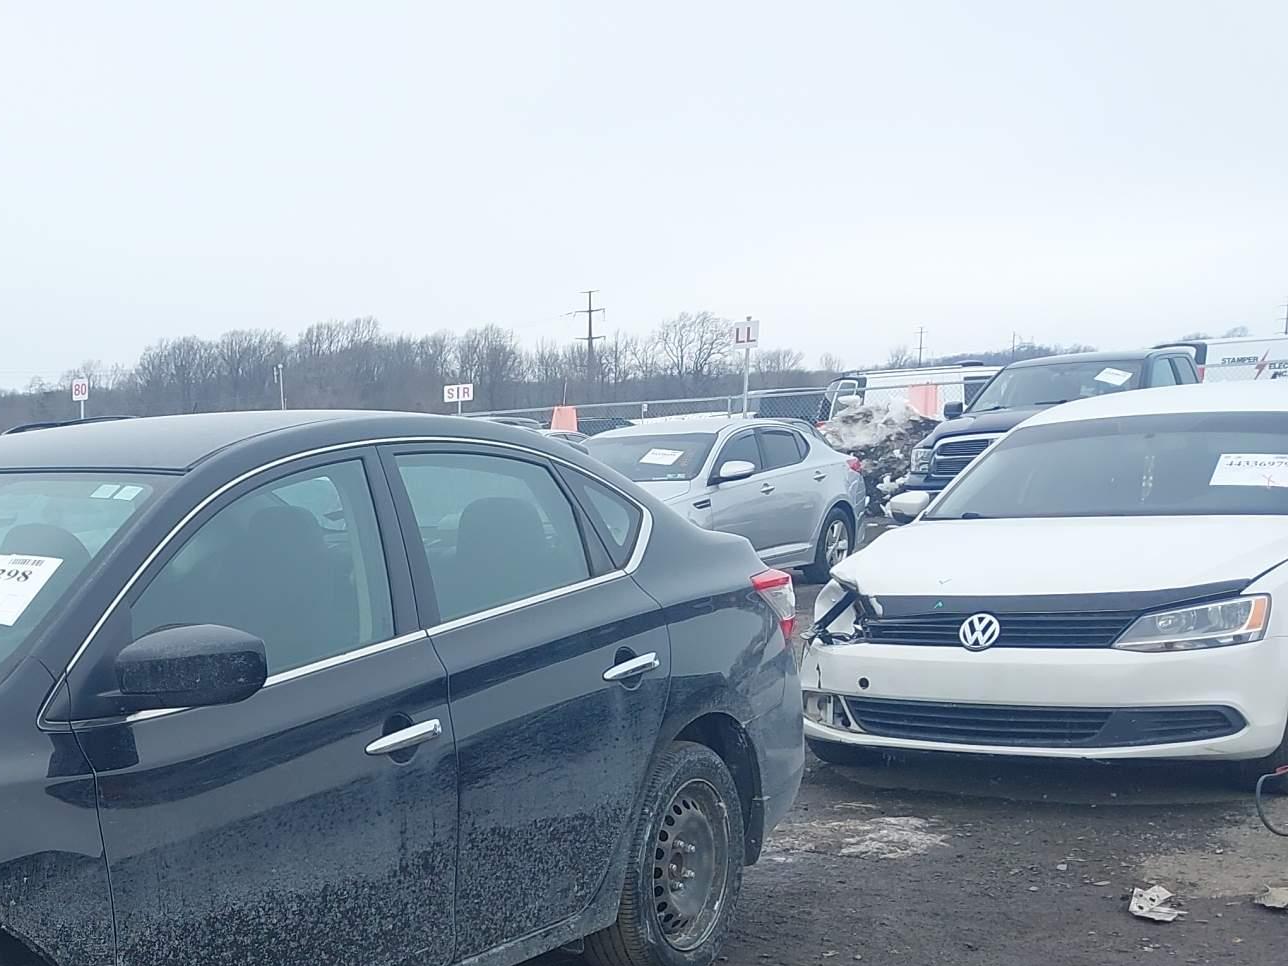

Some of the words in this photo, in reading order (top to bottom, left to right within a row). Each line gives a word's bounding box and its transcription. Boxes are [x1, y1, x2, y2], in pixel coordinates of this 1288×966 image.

[735, 326, 756, 344] LL
[1221, 356, 1258, 365] STAMPER
[74, 383, 87, 396] 80
